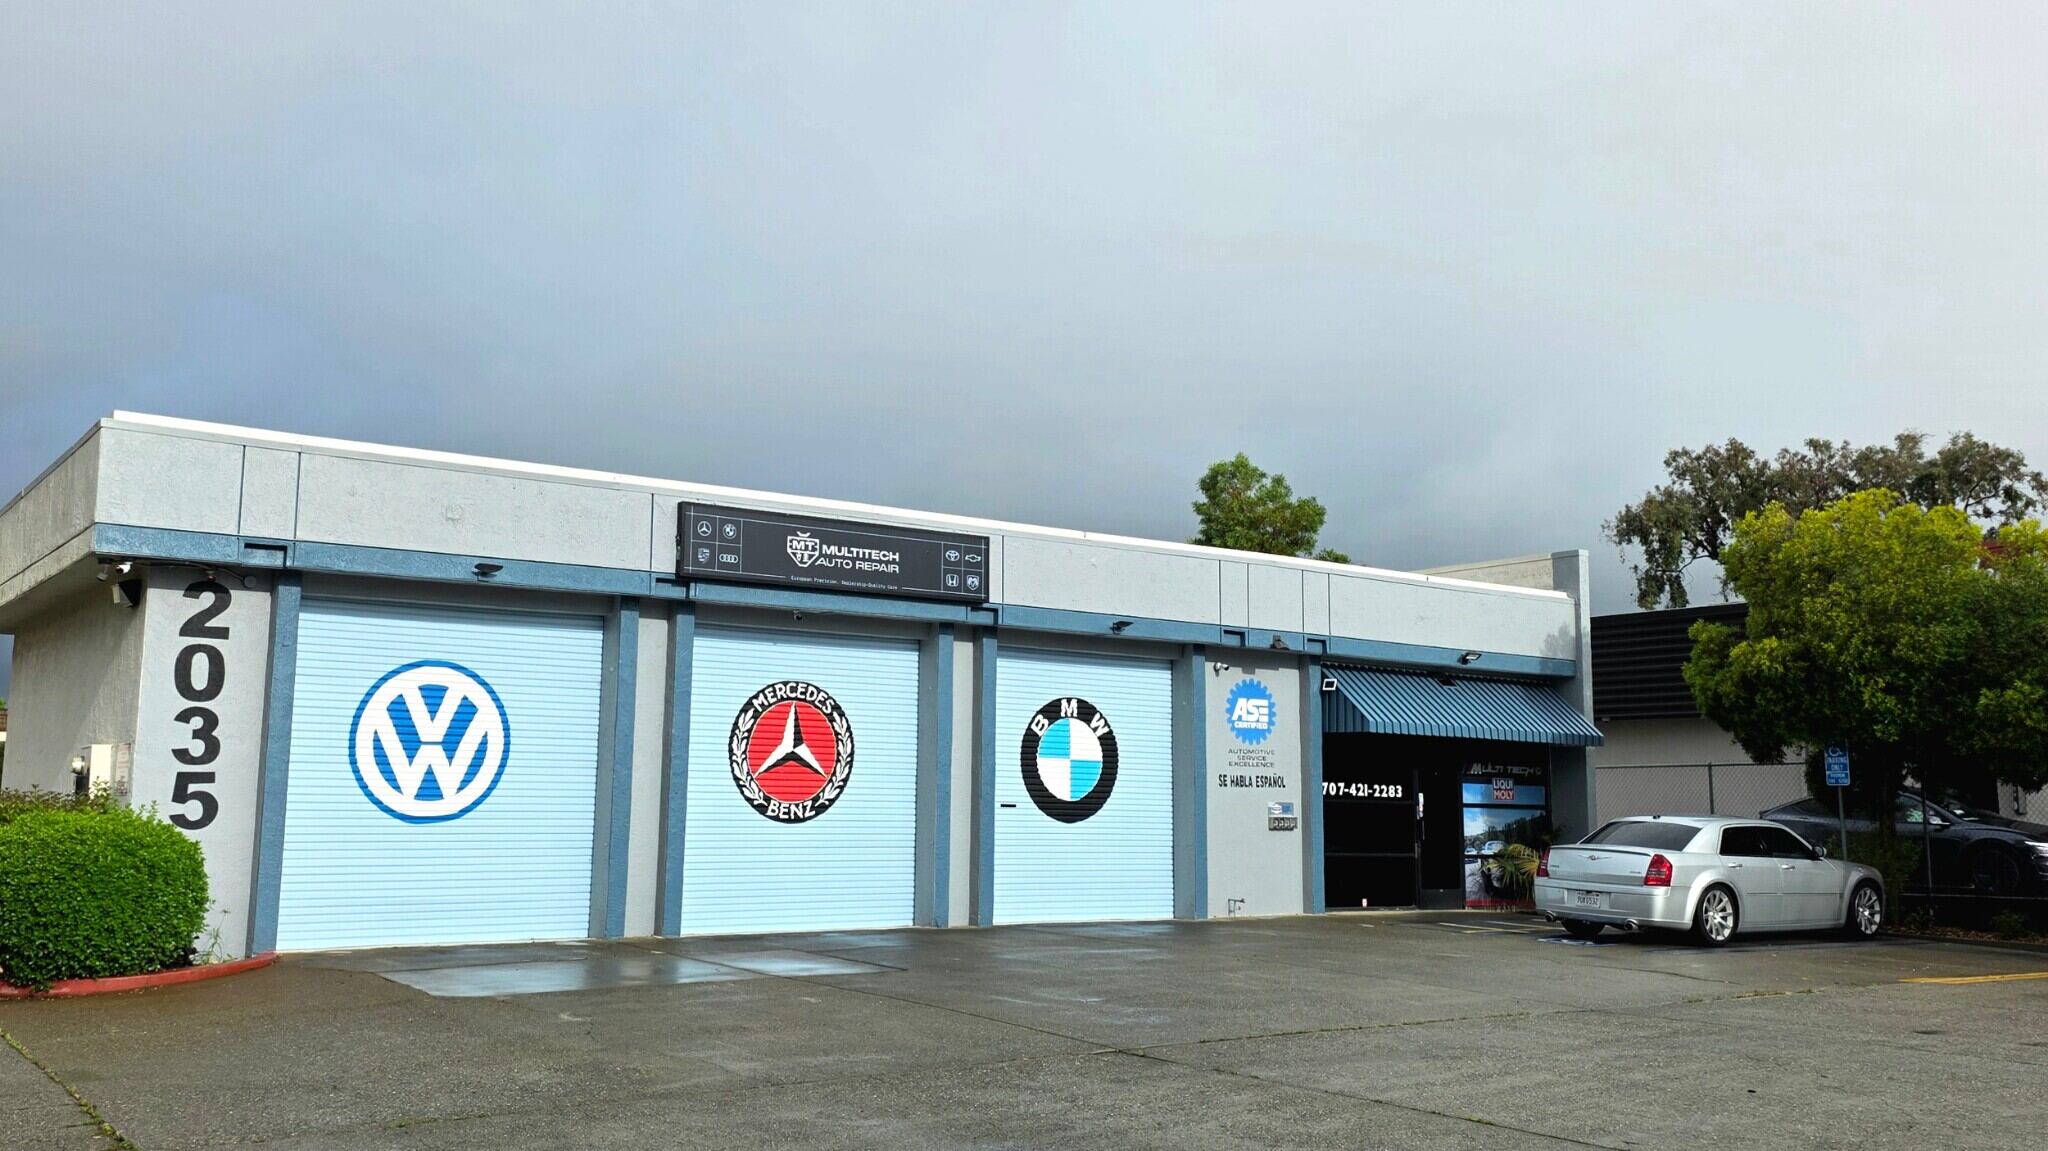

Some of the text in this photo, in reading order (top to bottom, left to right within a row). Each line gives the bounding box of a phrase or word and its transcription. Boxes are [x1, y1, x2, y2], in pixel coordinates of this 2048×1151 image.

[791, 540, 815, 551] MT
[822, 544, 899, 562] MULTITECH
[815, 557, 900, 574] AUTO REPAIR
[168, 581, 233, 831] 2035
[752, 682, 836, 714] MERCEDES
[1031, 698, 1109, 738] BMW
[1231, 697, 1269, 722] ASE
[1234, 721, 1269, 730] CERTIFIED
[1218, 773, 1286, 789] SE HABLA ESPAÑOL
[1493, 779, 1514, 789] LIQUI
[1322, 782, 1403, 798] 707-421-2283
[1493, 790, 1515, 800] MOLY
[765, 799, 816, 819] BENZ
